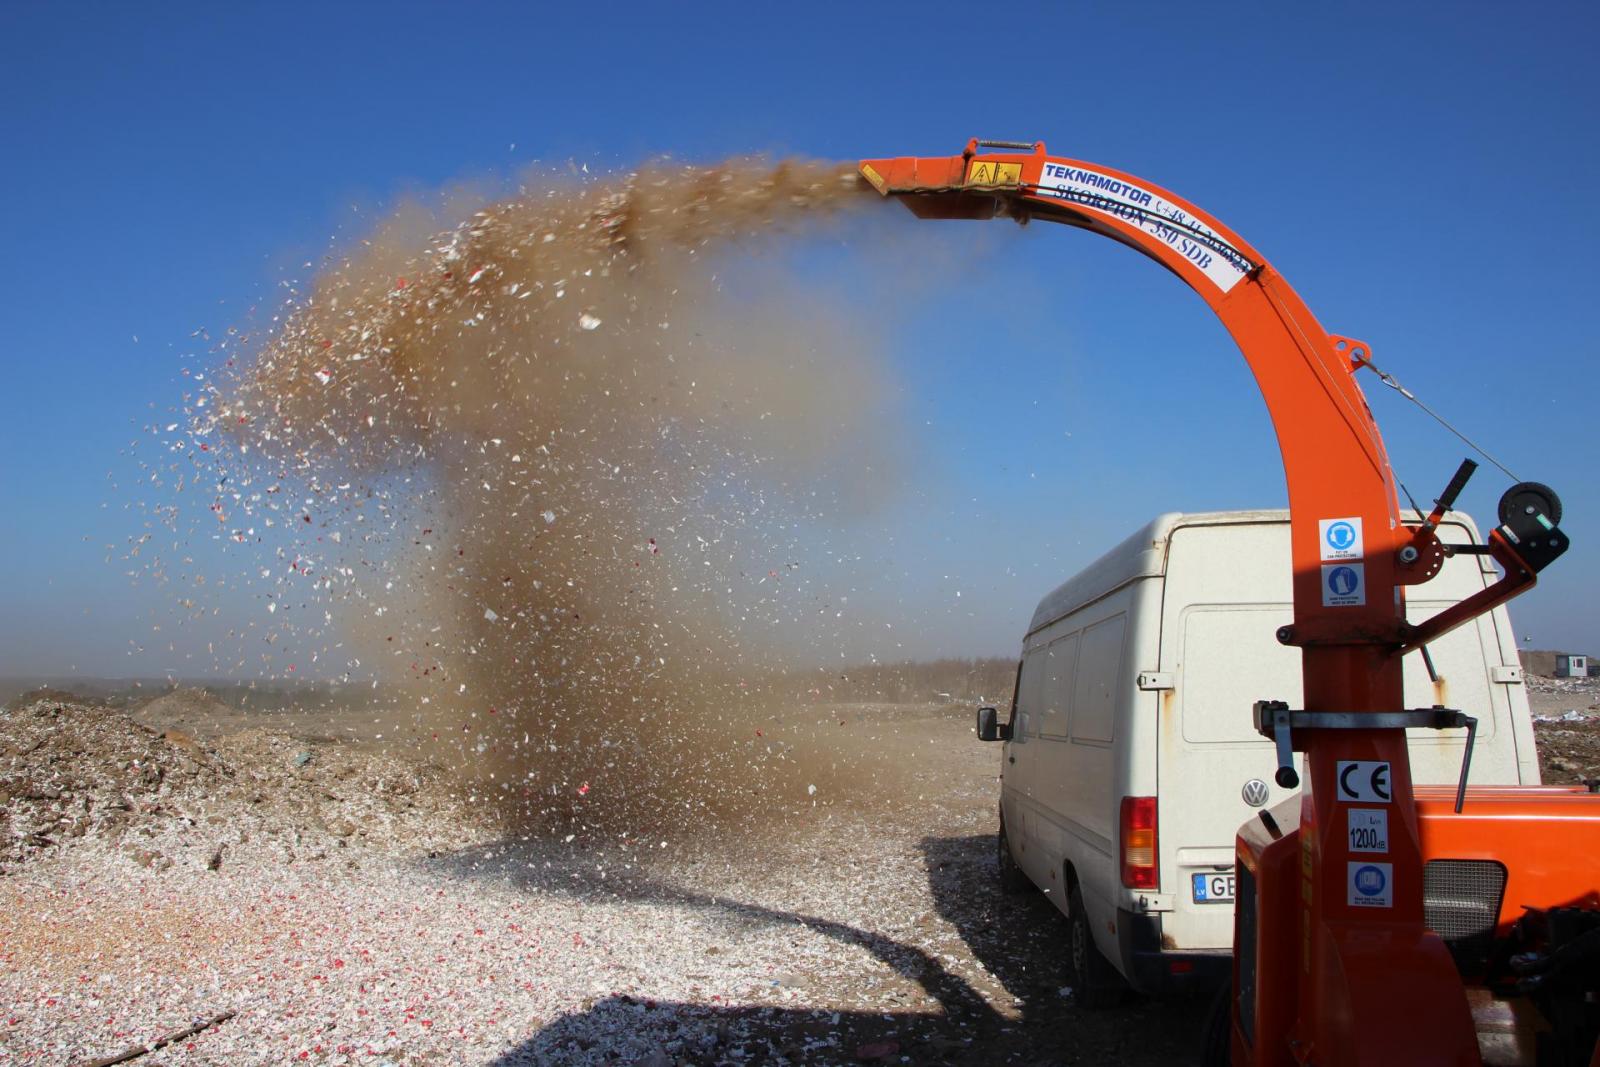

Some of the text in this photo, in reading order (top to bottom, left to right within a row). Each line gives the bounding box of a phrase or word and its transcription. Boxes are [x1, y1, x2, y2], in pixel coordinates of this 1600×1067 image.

[1046, 164, 1153, 206] TEKNAMOTOR
[1054, 183, 1148, 226] SKORPION
[1179, 238, 1213, 269] SDB
[1340, 763, 1390, 800] CE
